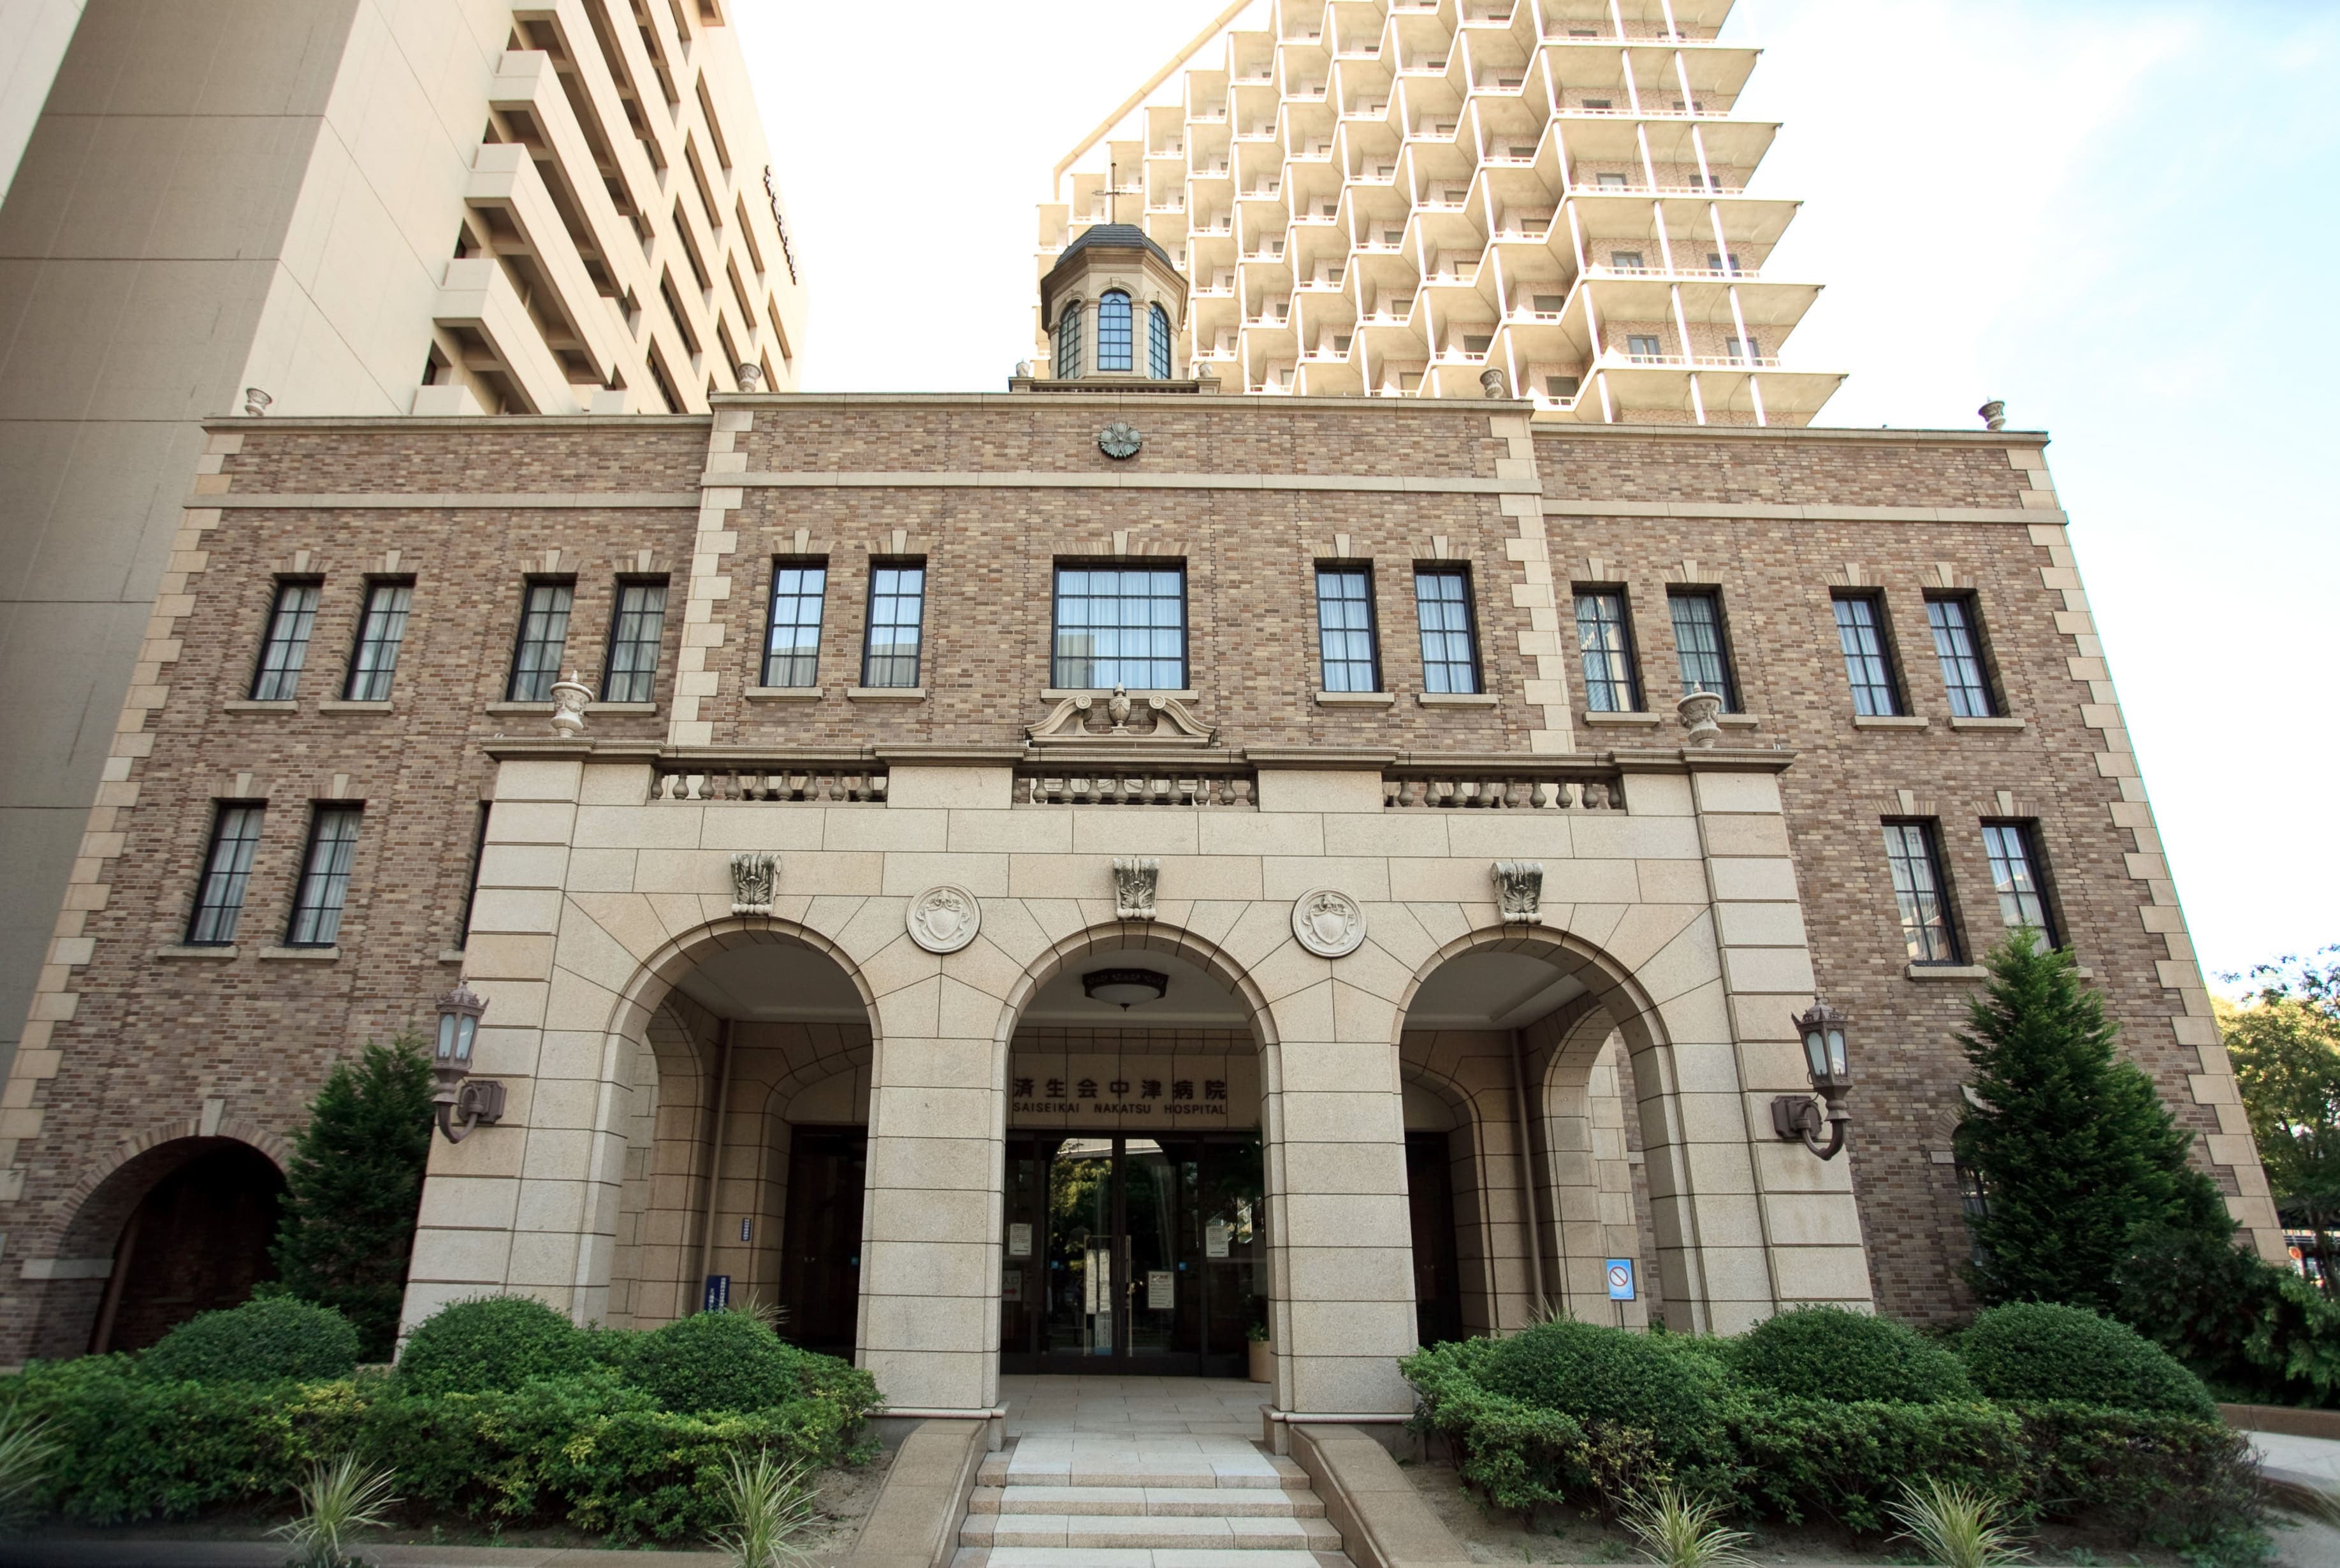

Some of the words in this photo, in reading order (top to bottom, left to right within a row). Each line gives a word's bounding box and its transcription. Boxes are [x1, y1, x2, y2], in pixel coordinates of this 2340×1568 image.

[1014, 1078, 1226, 1100] 済生会中津病院
[1013, 1102, 1079, 1113] SAISEIKAI
[1094, 1103, 1151, 1114] NAKATSU
[1164, 1104, 1226, 1115] HOSPITAL
